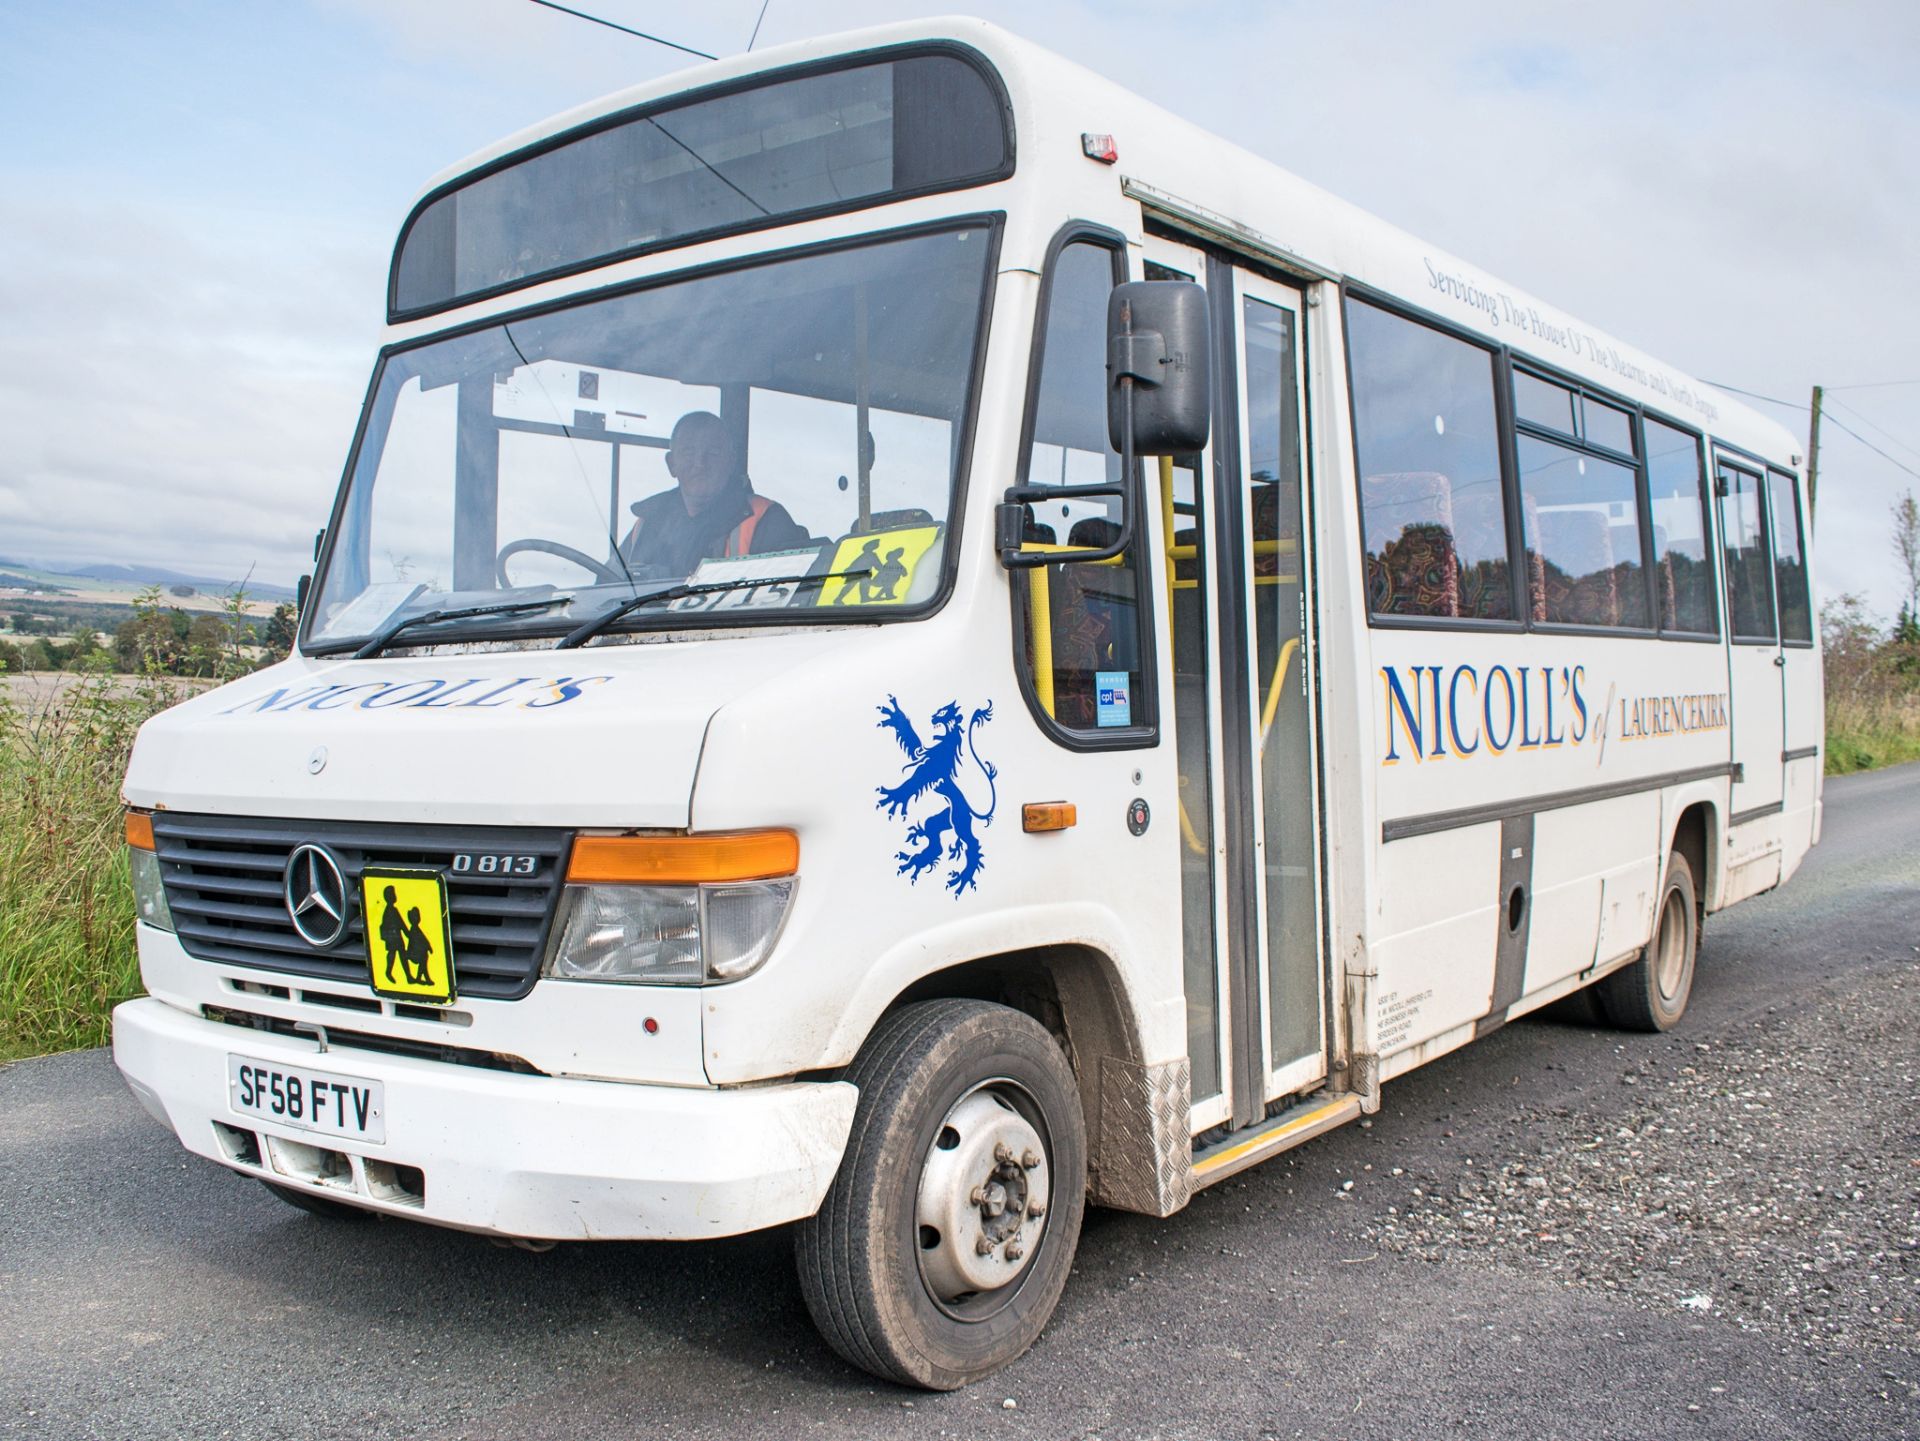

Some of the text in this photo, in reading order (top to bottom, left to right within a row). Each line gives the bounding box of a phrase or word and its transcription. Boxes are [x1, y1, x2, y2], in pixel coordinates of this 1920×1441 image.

[1423, 256, 1500, 327] Servicing
[1497, 292, 1528, 331] The
[1528, 308, 1568, 349] Howe
[1583, 335, 1611, 369] The
[1648, 370, 1669, 397] and
[213, 675, 617, 717] NICOLL'S
[1101, 692, 1113, 704] cpt
[1379, 664, 1729, 769] NICOLL'S of LAURENCEKIRK
[478, 855, 537, 874] 813
[238, 1064, 371, 1132] SF58 FTV
